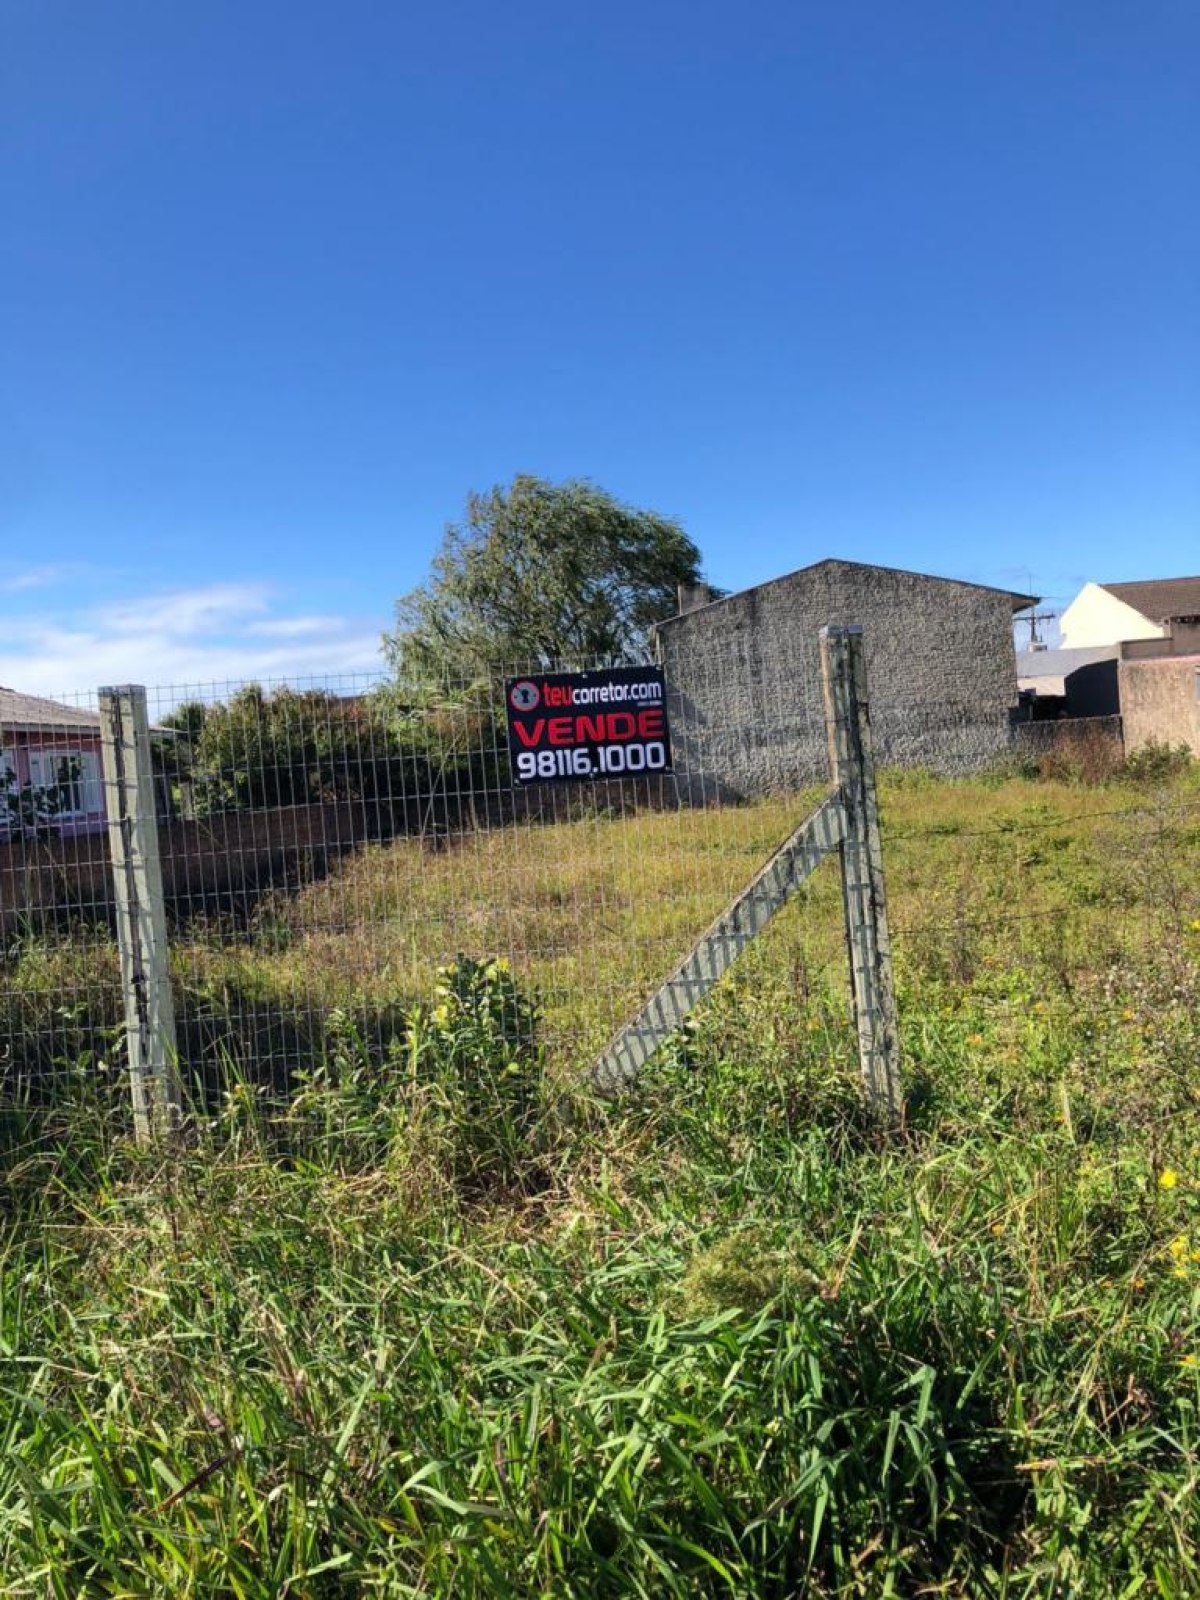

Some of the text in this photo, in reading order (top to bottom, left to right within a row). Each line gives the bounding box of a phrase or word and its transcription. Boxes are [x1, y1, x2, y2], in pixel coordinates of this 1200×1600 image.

[543, 681, 662, 707] teucorretor.com
[513, 709, 664, 747] VENDE
[516, 742, 665, 779] 98116.1000
